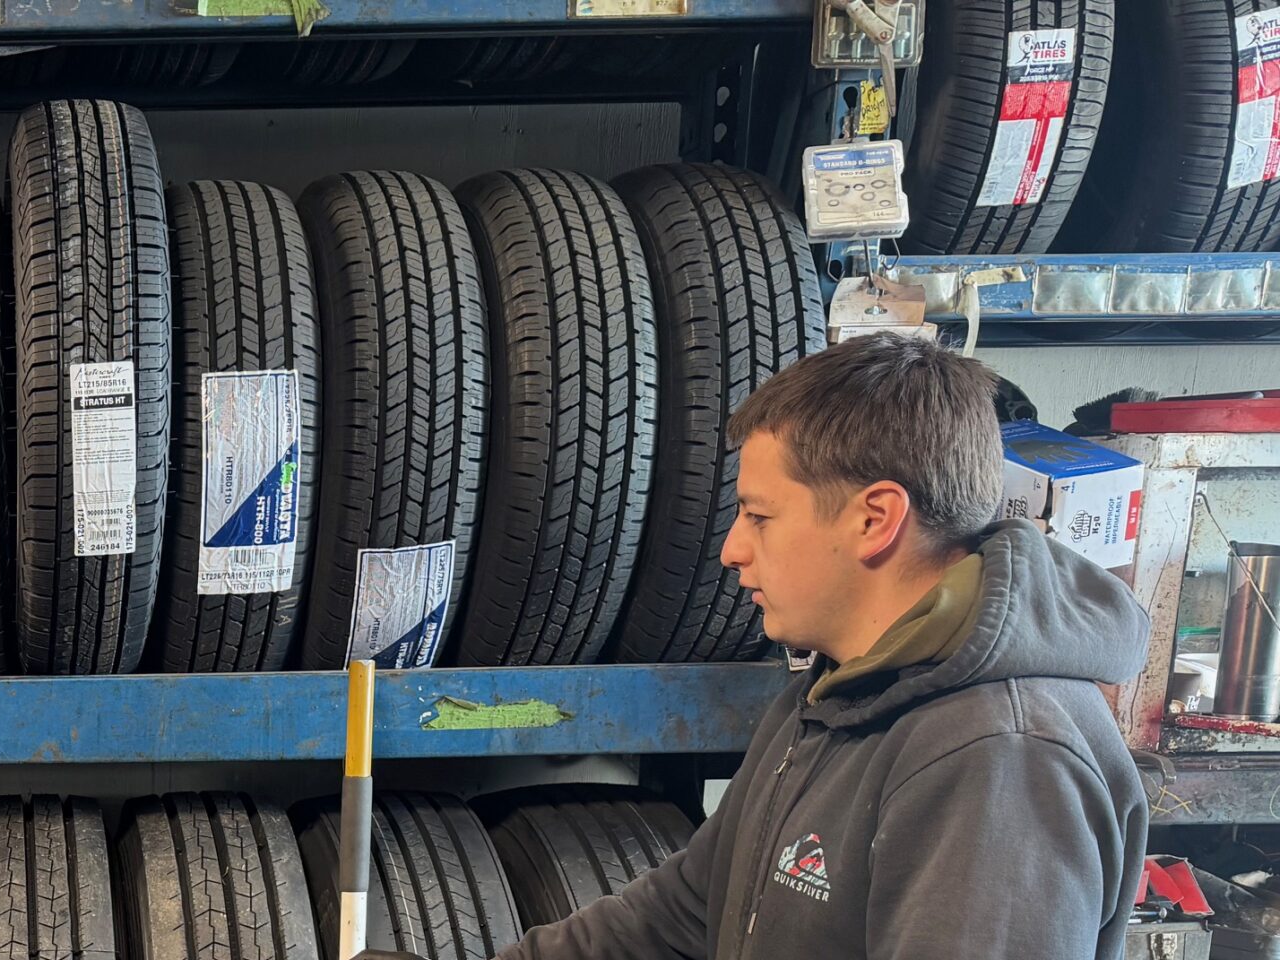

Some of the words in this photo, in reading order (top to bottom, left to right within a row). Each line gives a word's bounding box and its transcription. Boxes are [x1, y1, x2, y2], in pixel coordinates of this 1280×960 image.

[1032, 50, 1066, 60] TIRES
[1033, 40, 1066, 50] ATLAS
[78, 378, 126, 388] LT215/85R16
[80, 397, 114, 406] STRATUS
[115, 396, 126, 404] HT
[224, 456, 234, 504] HTR80110
[254, 496, 266, 545] HTR-800
[1092, 516, 1101, 534] H2O
[1104, 498, 1115, 545] WATERPROOF
[1112, 495, 1123, 544] IMPERMEABLE
[773, 871, 830, 902] QUIKSILVER
